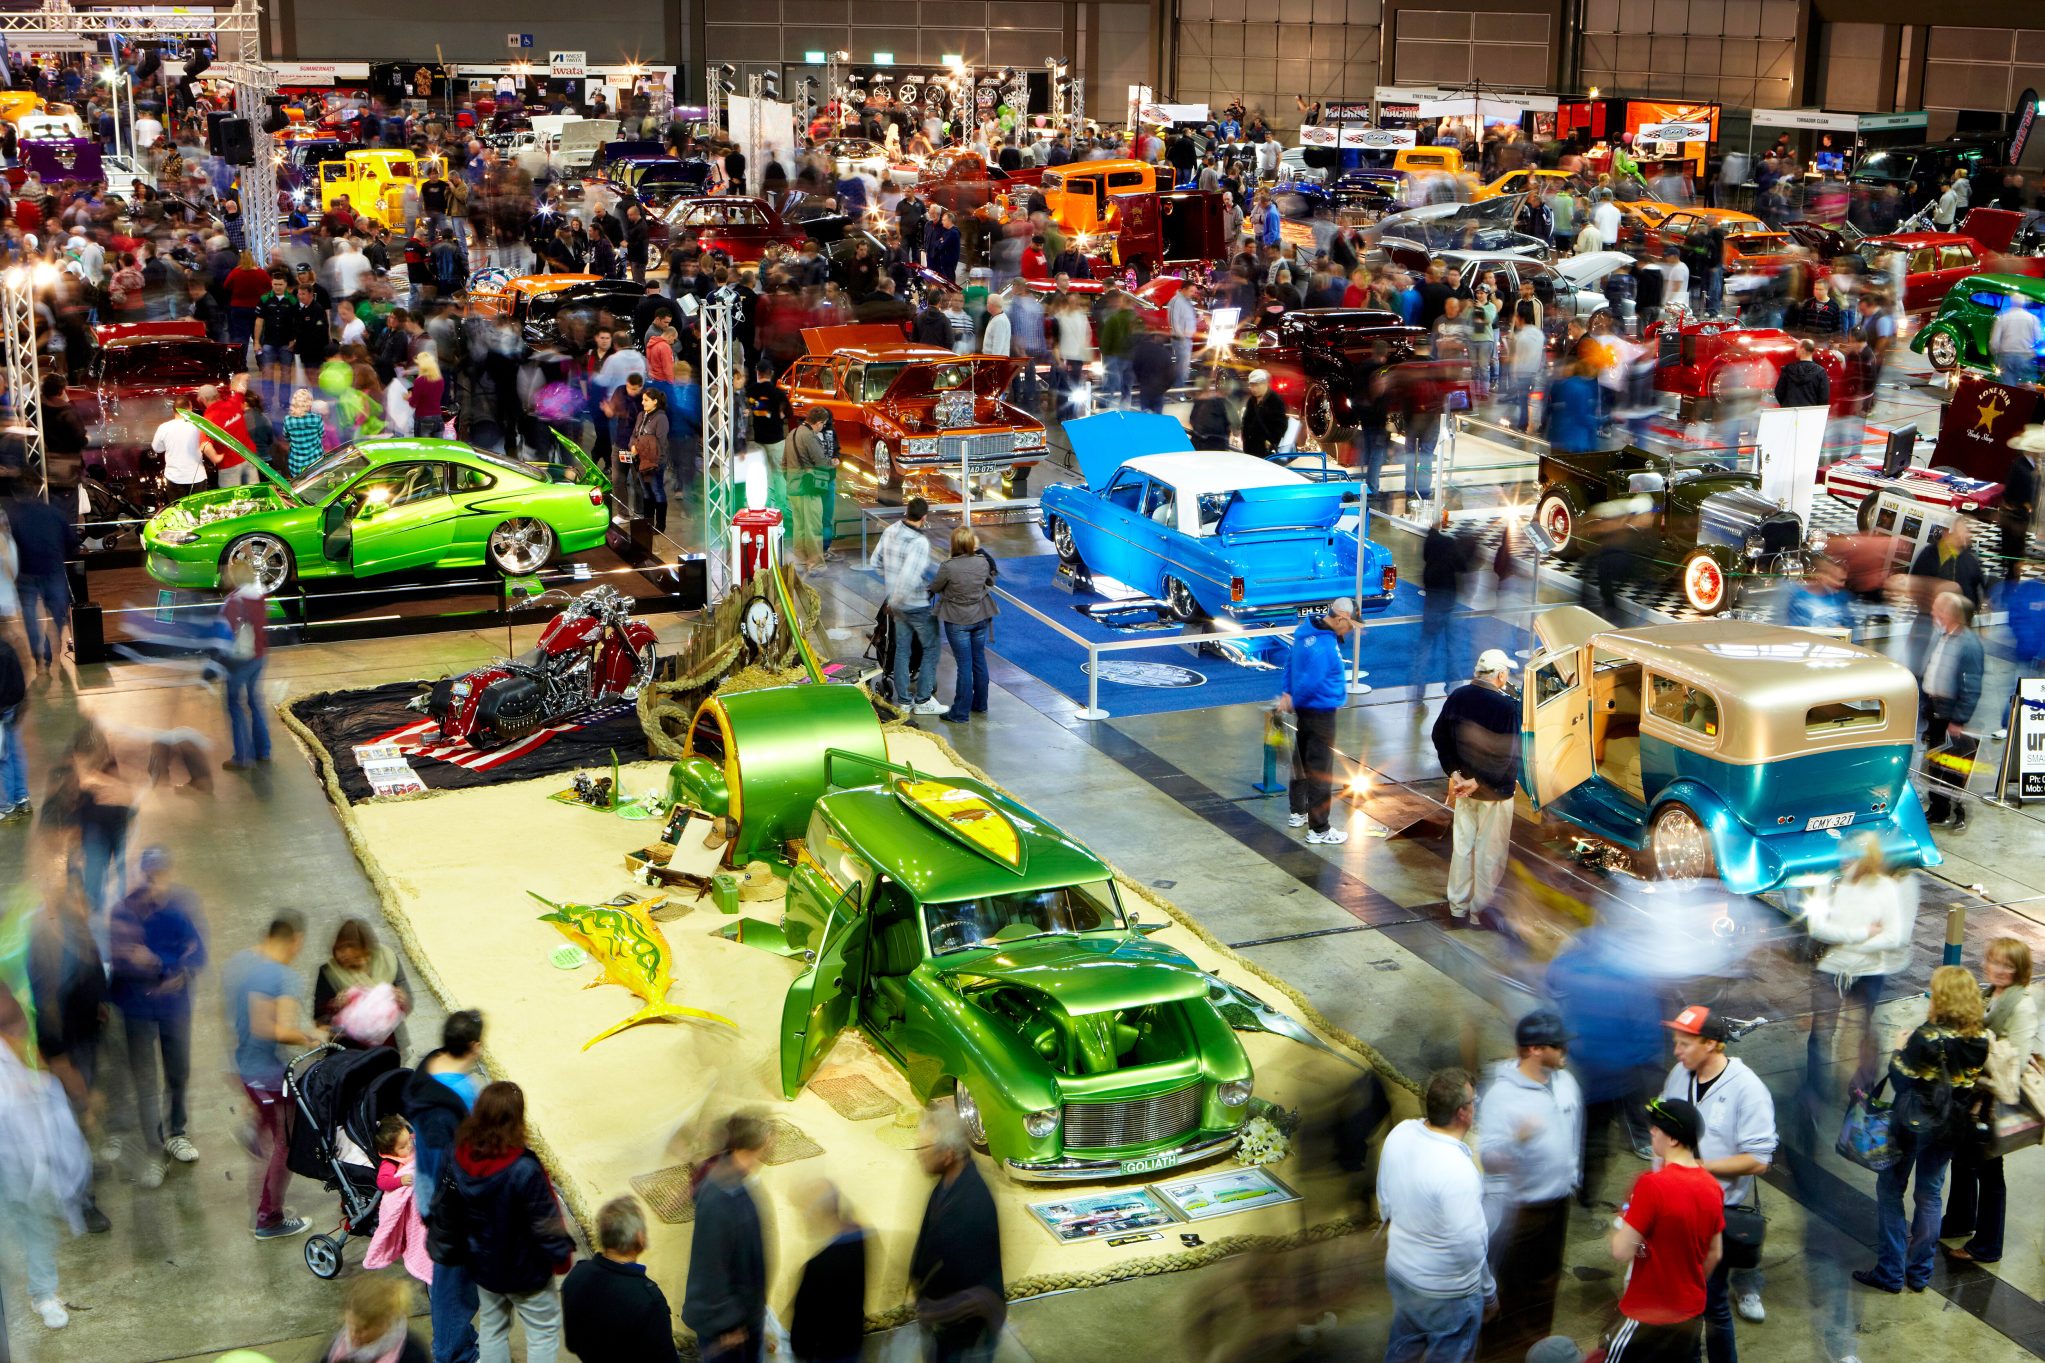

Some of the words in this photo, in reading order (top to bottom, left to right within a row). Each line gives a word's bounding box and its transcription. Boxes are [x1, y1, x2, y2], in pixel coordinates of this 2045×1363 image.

[553, 66, 584, 75] iwata
[1326, 107, 1369, 118] MACHINE
[1381, 108, 1419, 118] MACHIN
[1978, 387, 1998, 401] LONE
[1998, 388, 2011, 407] STAR
[1967, 428, 1981, 441] Body
[1981, 433, 1994, 444] Shop
[2029, 712, 2045, 721] str
[2027, 754, 2045, 763] SMA
[2029, 775, 2041, 784] Ph:
[2025, 785, 2043, 793] Mob:
[1127, 1155, 1177, 1173] GOLIATH
